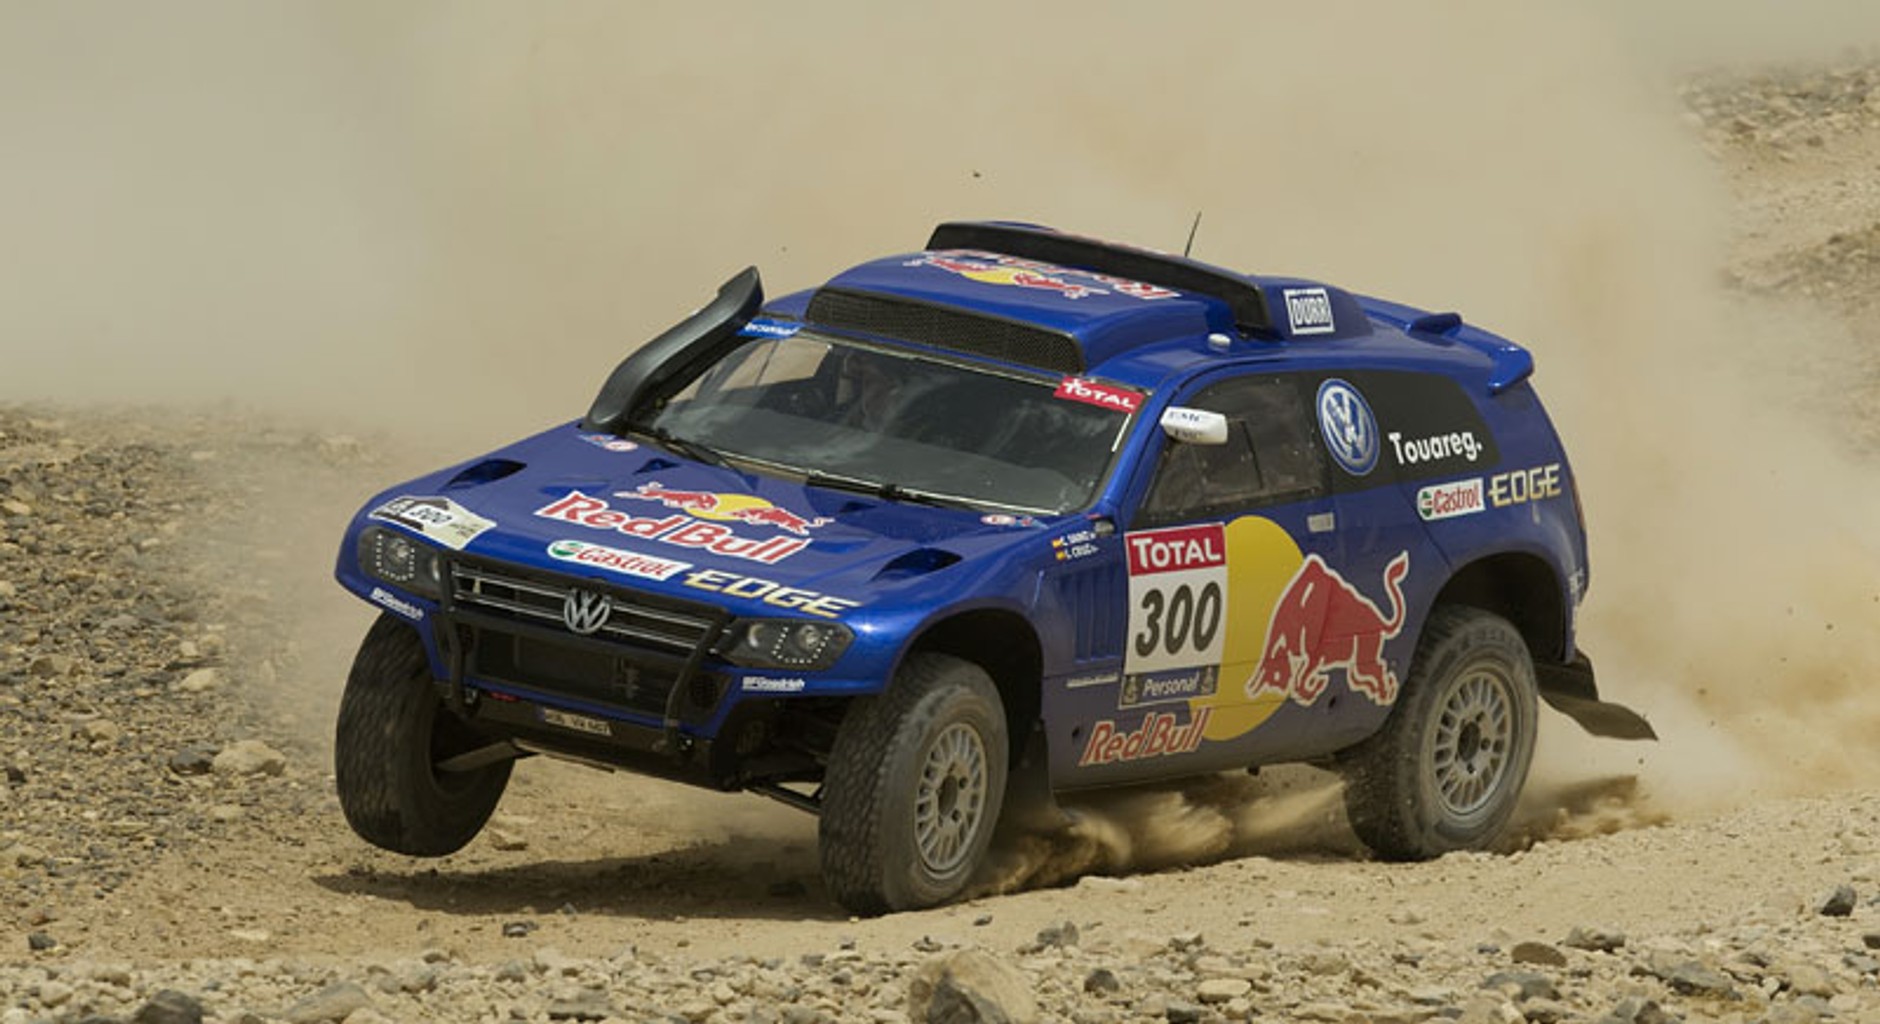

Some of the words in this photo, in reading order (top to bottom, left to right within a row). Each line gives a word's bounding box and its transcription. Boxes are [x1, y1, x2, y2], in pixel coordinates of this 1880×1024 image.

[1064, 379, 1135, 410] TOTAL
[1433, 483, 1482, 515] Castrol
[1488, 463, 1562, 507] EDGE
[1132, 537, 1222, 569] TOTAL
[576, 545, 679, 577] Castrol
[682, 569, 861, 618] EDGE
[1135, 580, 1221, 658] 300
[1142, 671, 1199, 697] Personal
